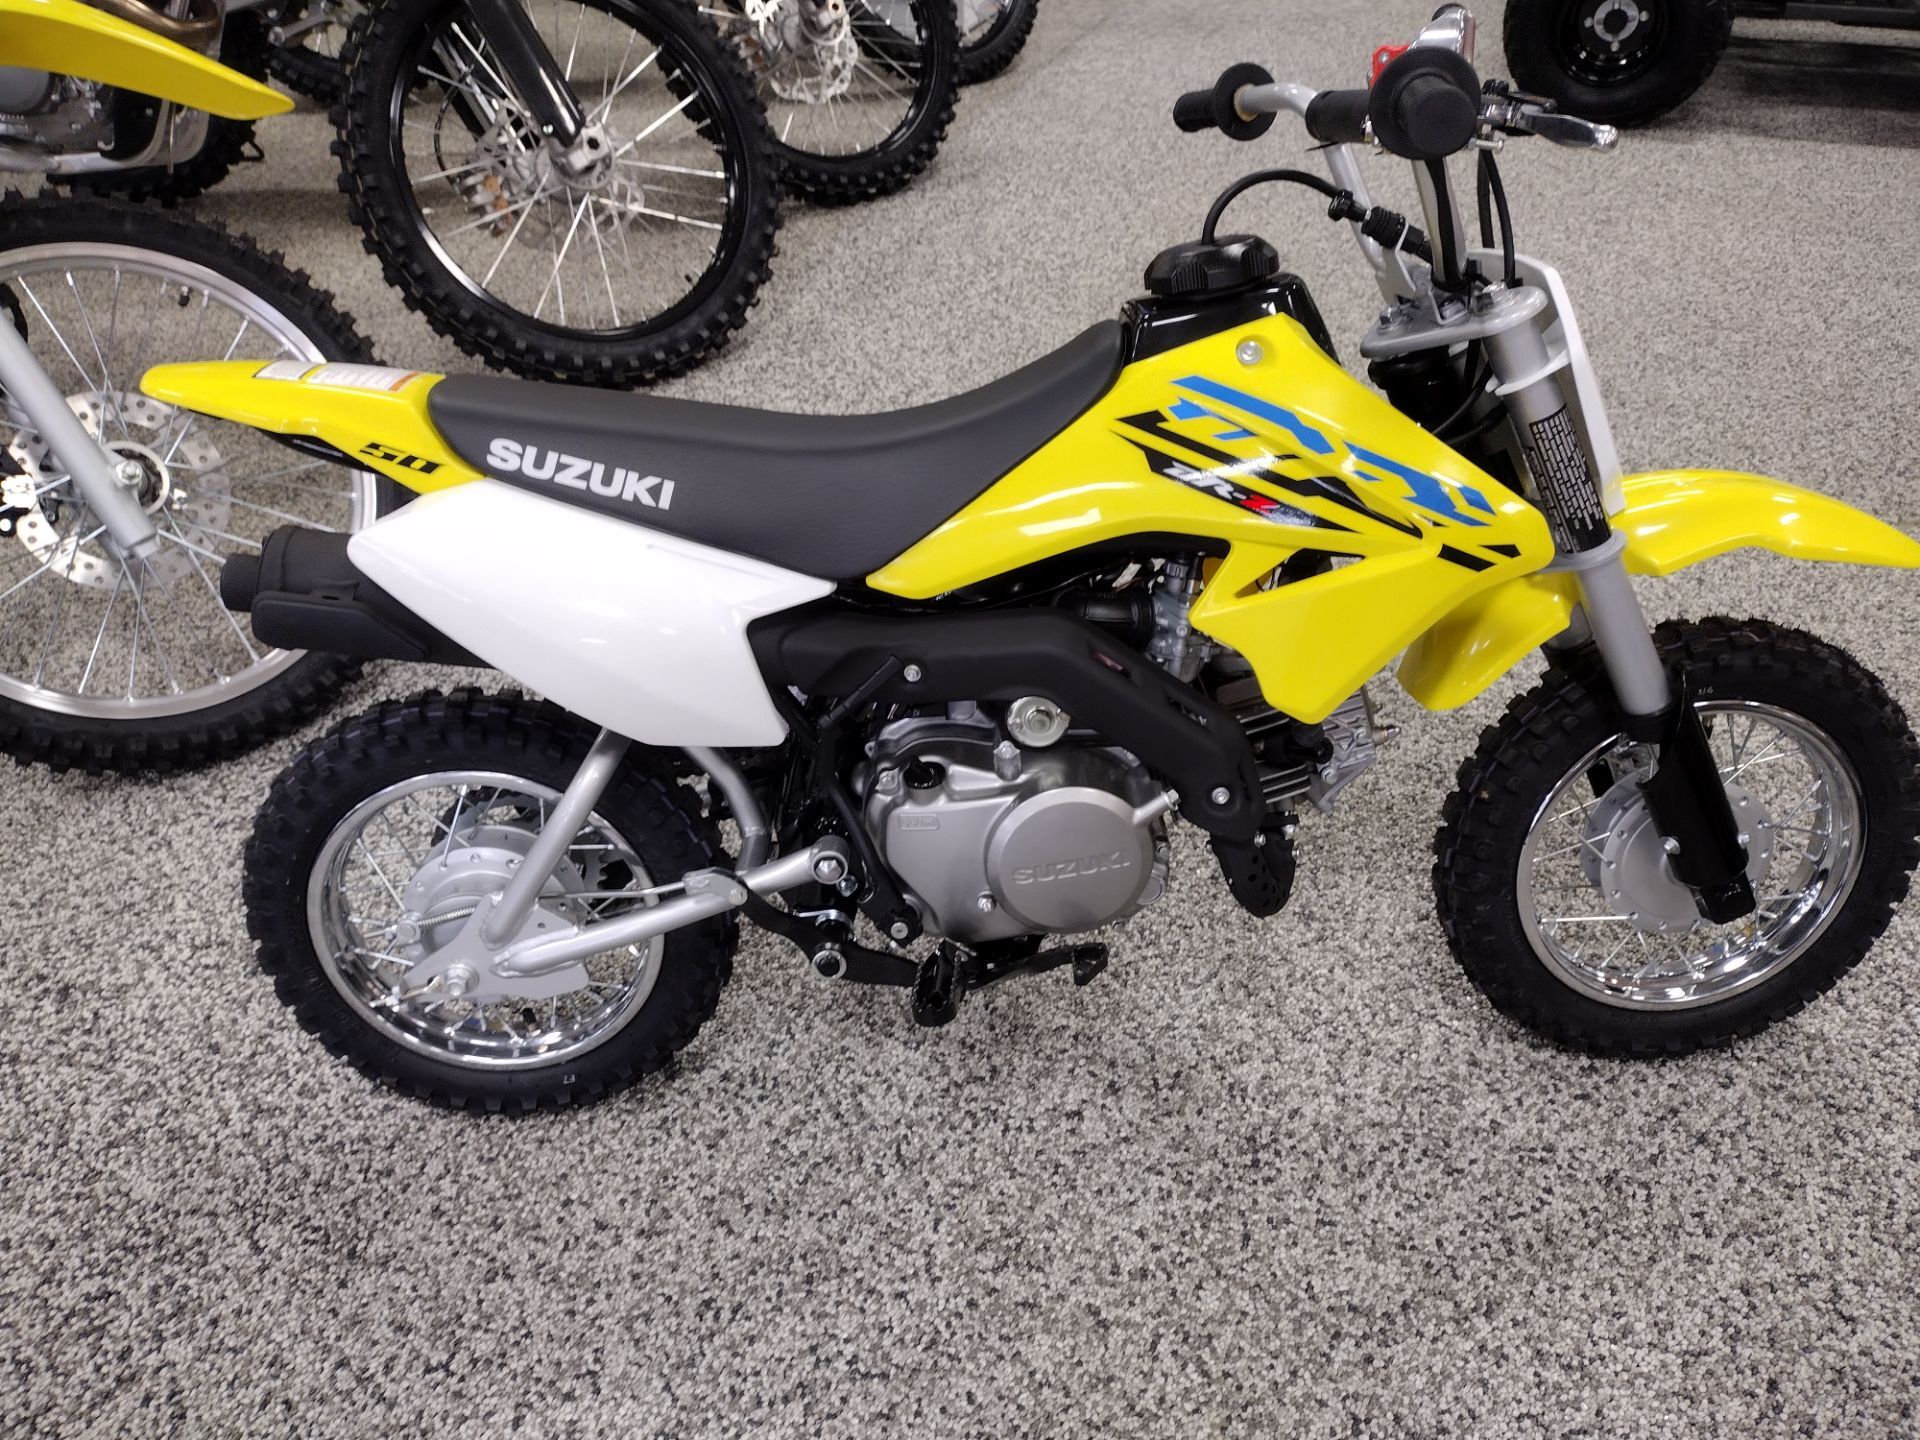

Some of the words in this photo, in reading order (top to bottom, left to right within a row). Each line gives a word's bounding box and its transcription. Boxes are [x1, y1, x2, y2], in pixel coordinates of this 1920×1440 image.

[359, 442, 441, 474] 50
[486, 437, 676, 511] SUZUKI
[1012, 849, 1131, 885] SUZUKI
